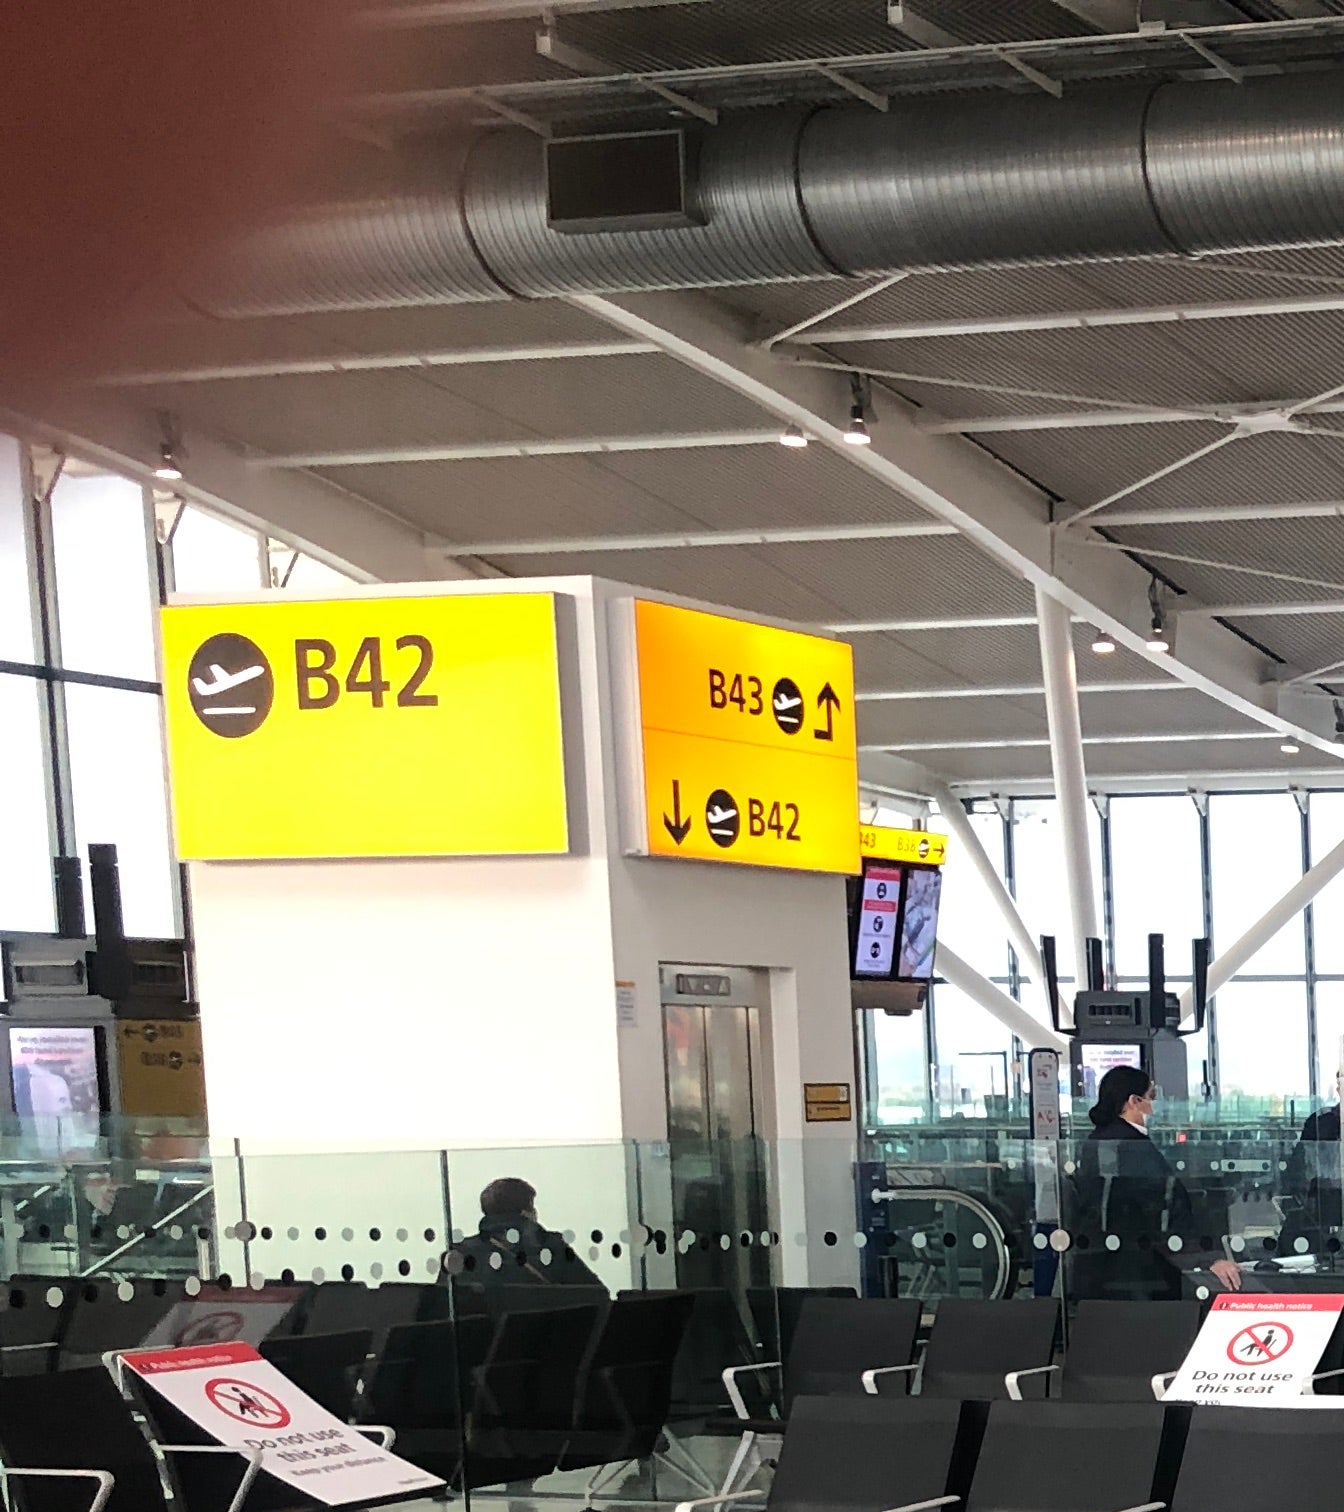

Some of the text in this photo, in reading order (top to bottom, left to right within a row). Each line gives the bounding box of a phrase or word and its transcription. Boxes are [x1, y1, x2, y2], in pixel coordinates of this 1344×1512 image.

[294, 634, 439, 711] B42
[709, 669, 764, 714] B43
[749, 798, 801, 841] B42
[1257, 1302, 1284, 1310] health
[1192, 1370, 1293, 1382] Do not use
[1195, 1383, 1275, 1394] this seat
[244, 1438, 278, 1450] Do
[276, 1433, 313, 1447] not
